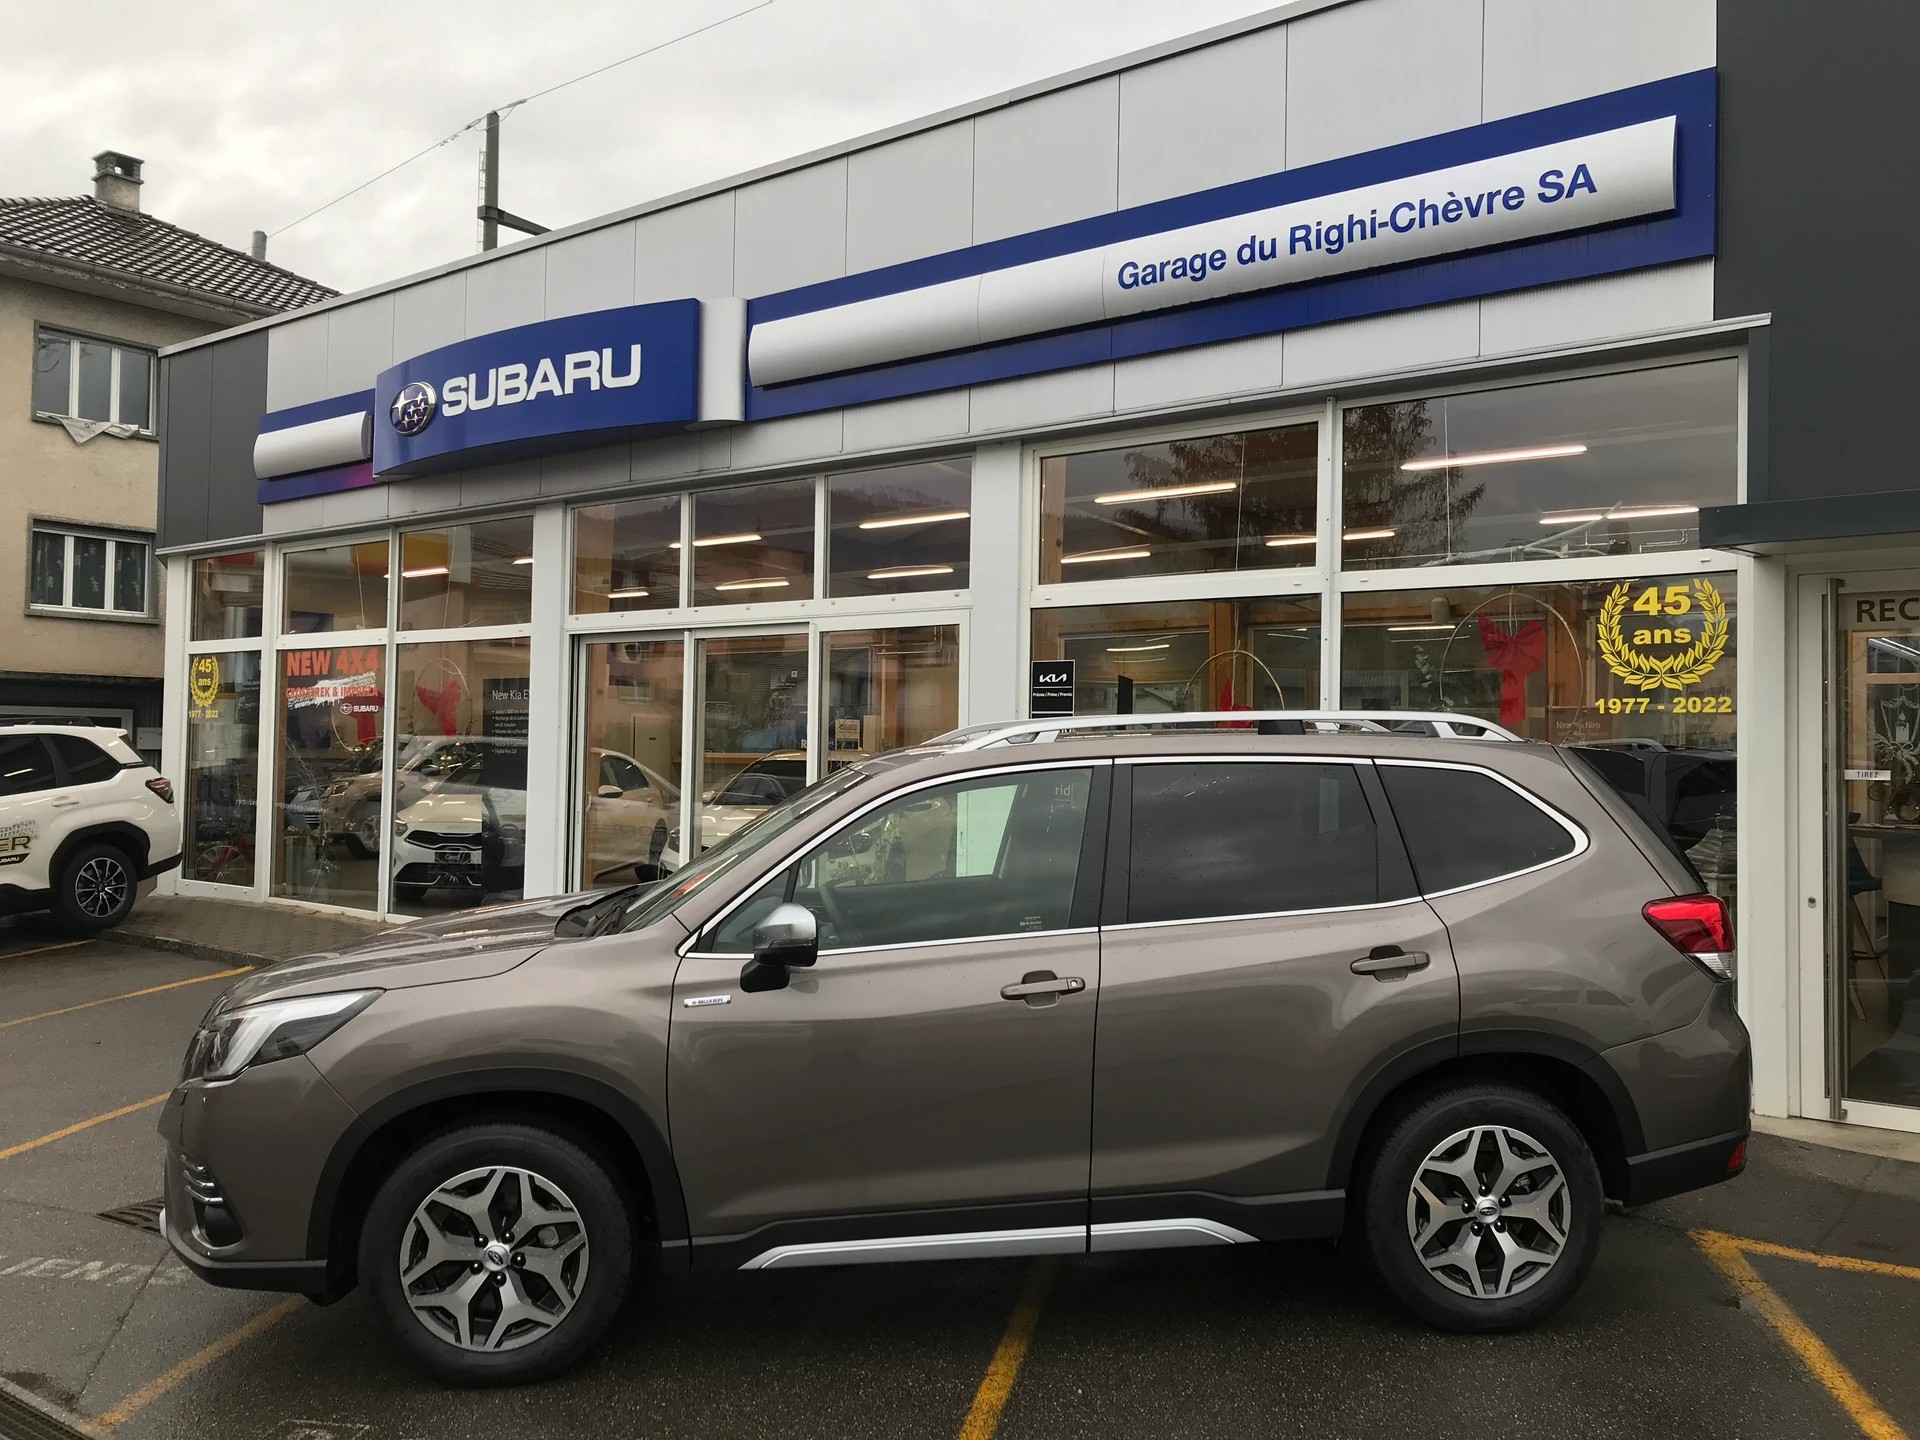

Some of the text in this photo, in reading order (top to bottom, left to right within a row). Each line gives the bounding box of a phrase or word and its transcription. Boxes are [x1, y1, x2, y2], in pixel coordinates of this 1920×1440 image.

[1117, 163, 1598, 291] Garage du Righi-Chèvre SA
[441, 343, 642, 417] SUBARU
[1633, 585, 1692, 616] 45
[1633, 627, 1692, 645] ans
[198, 658, 212, 673] 45
[286, 647, 379, 676] NEW 4X4
[197, 678, 211, 686] ans
[492, 689, 509, 700] New
[509, 689, 522, 700] Kia
[353, 704, 379, 712] SUBARU
[1595, 697, 1651, 714] 1977
[1672, 696, 1733, 714] 2022
[188, 710, 201, 718] 1977
[1585, 720, 1601, 729] Niro
[1856, 771, 1879, 779] TIREZ
